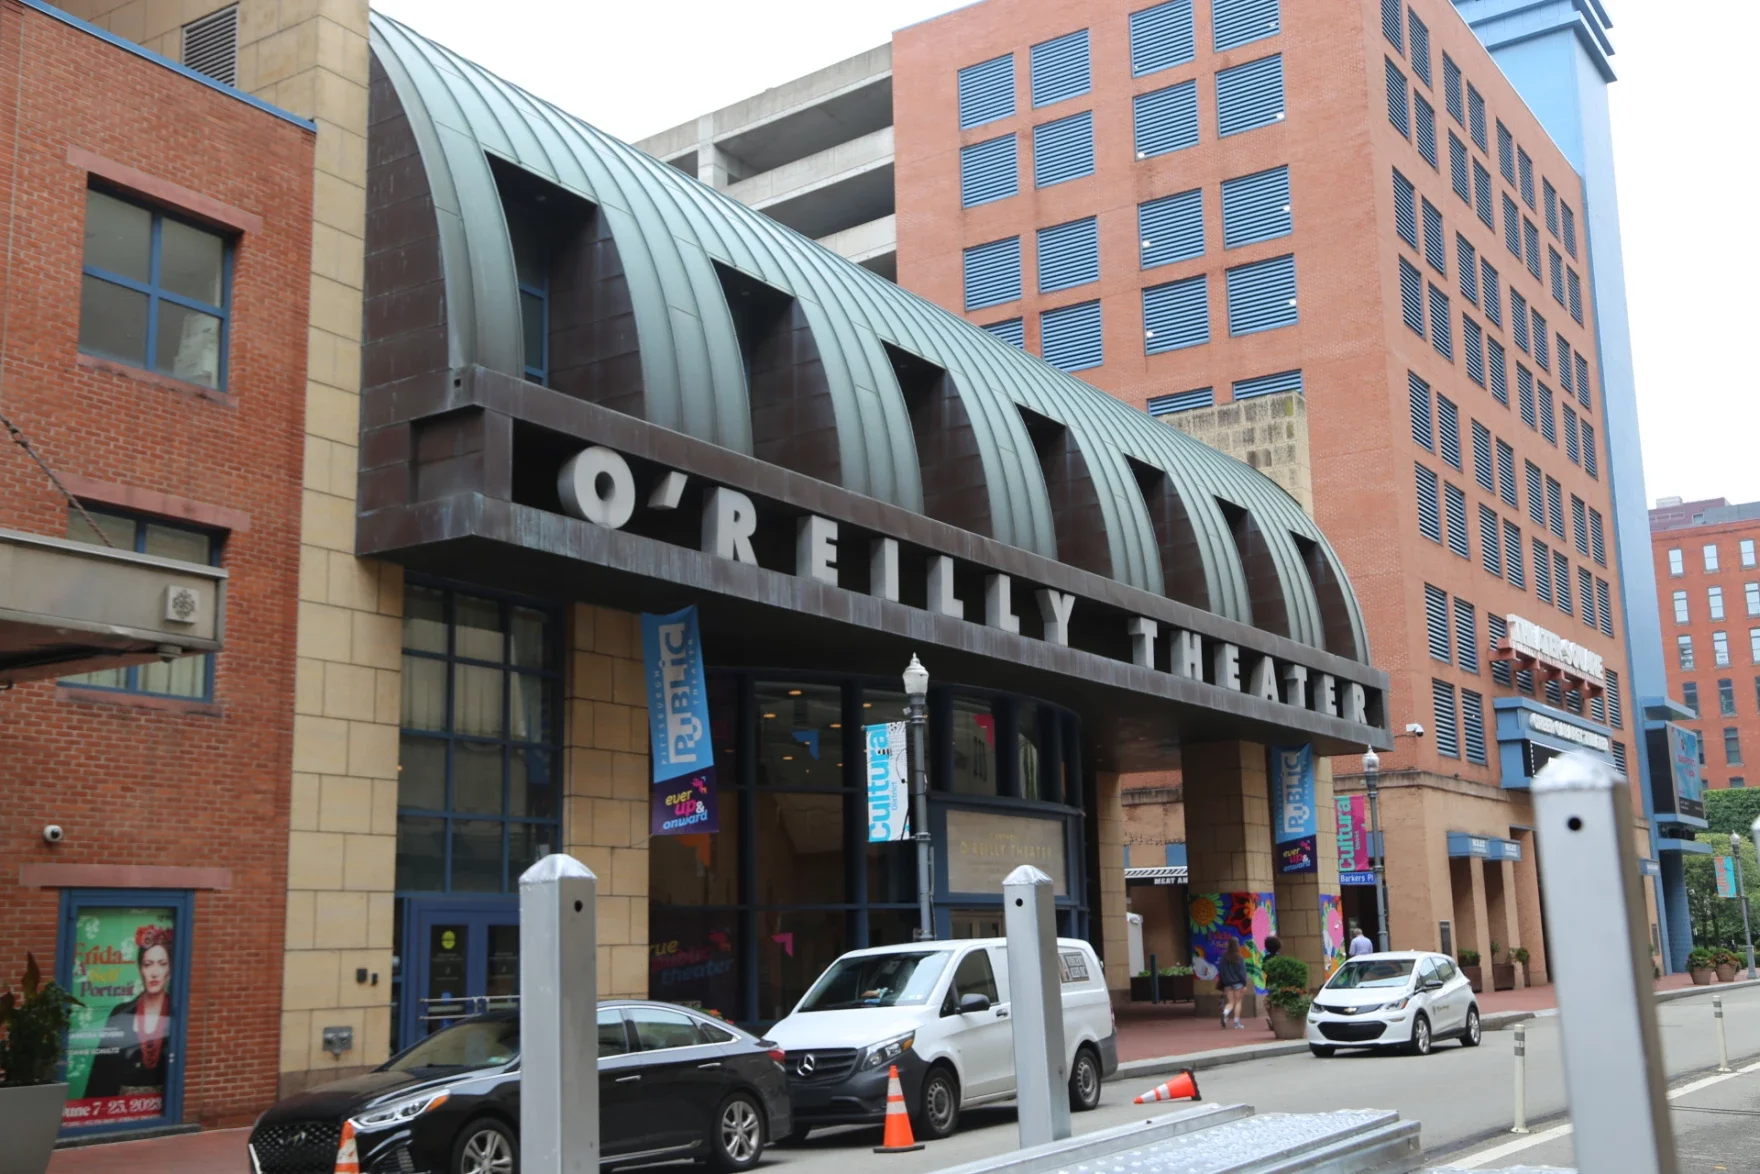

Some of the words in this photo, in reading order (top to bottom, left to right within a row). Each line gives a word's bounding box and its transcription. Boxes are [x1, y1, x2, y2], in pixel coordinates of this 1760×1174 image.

[557, 445, 1075, 647] O'REILLY
[1128, 617, 1367, 724] THEATER
[658, 622, 703, 764] PUBLIC
[653, 669, 668, 765] PITTSBURGH
[665, 789, 693, 806] ever
[1281, 751, 1310, 833] PUBLIC
[663, 808, 708, 829] onward
[1336, 796, 1355, 872] Cultural
[960, 841, 1006, 857] OREILLY
[1283, 847, 1300, 858] ever
[1283, 859, 1311, 873] onward
[1154, 877, 1176, 885] MEAT
[1177, 876, 1188, 884] AN
[1340, 874, 1366, 883] Barkers
[1367, 873, 1374, 882] Pl
[650, 940, 678, 955] rue
[81, 979, 135, 998] Portrait
